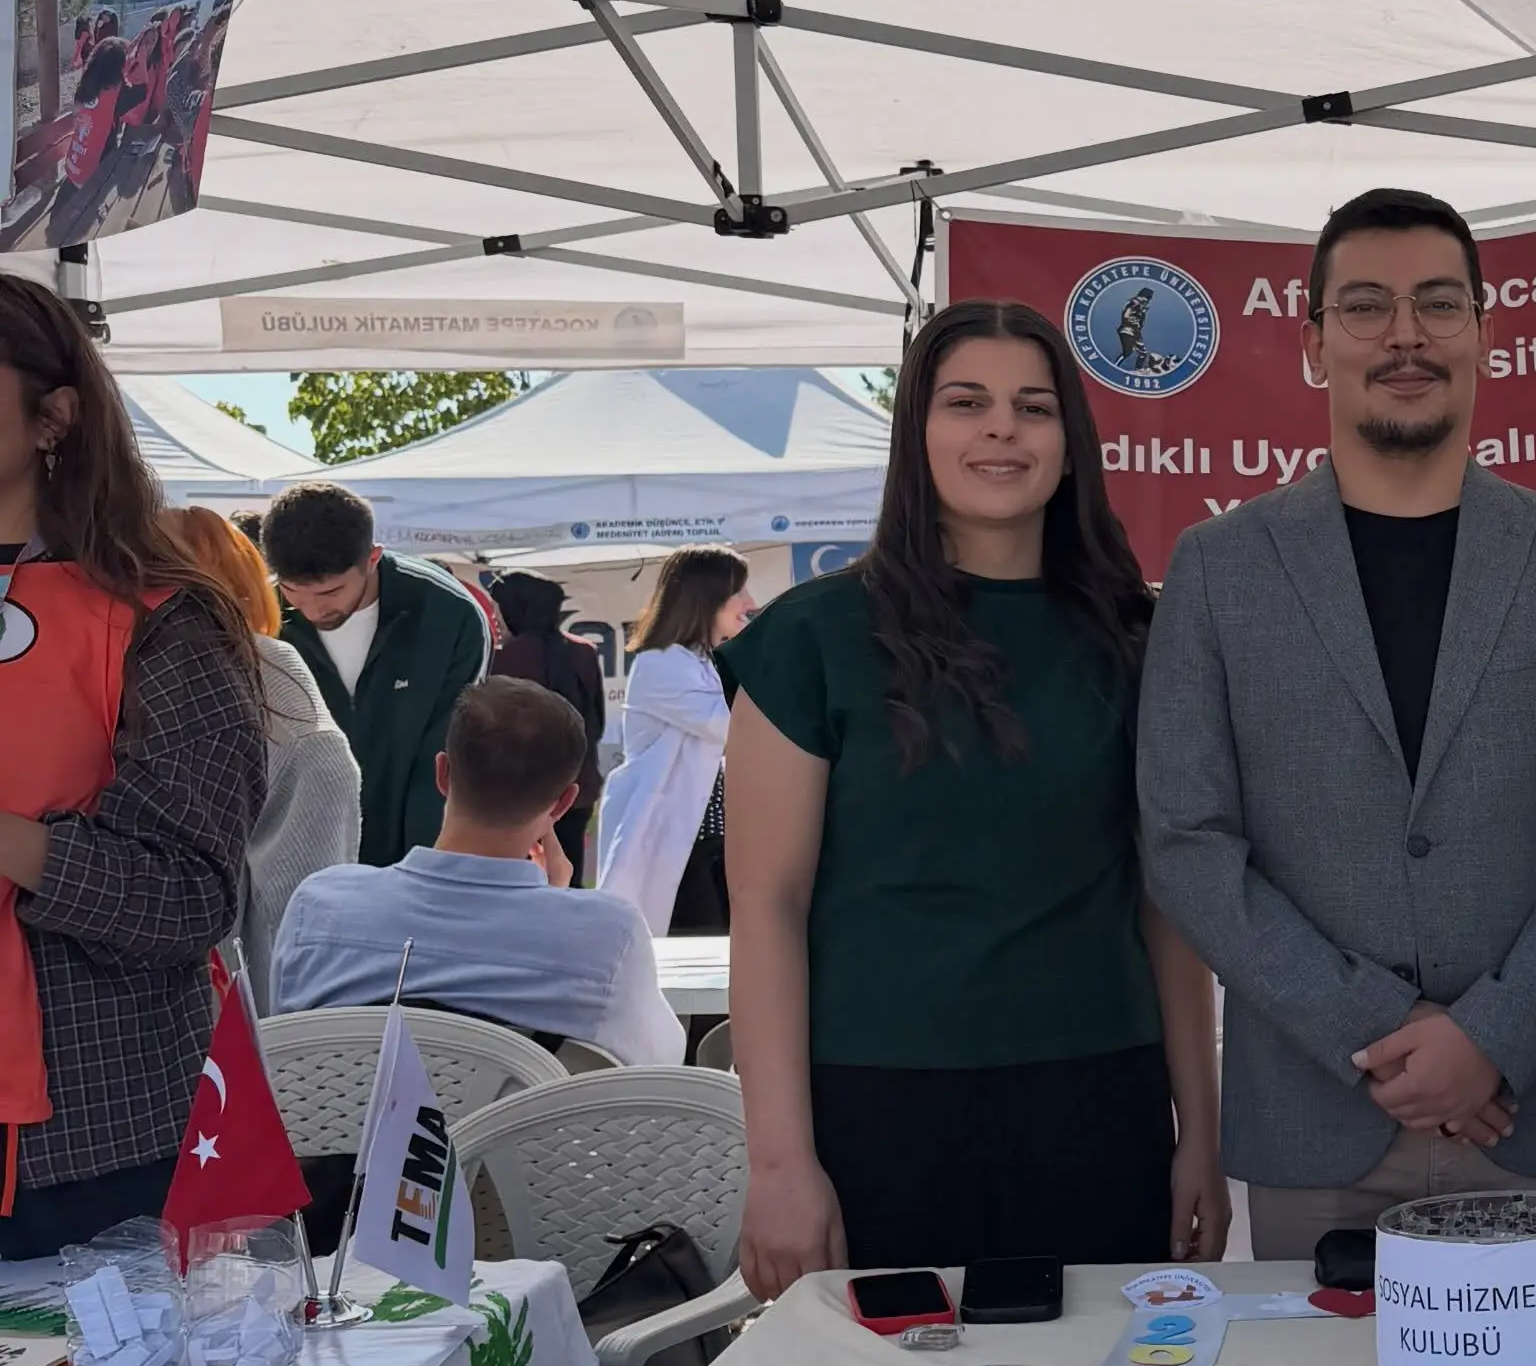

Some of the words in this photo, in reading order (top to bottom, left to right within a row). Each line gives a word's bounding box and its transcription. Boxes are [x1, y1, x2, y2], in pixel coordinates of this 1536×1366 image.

[1080, 265, 1150, 307] KOCATEPE
[1075, 314, 1099, 361] AFYON
[1100, 434, 1210, 474] dıklı
[390, 1105, 449, 1246] TEMA
[1379, 1275, 1439, 1311] SOSYAL
[1400, 1326, 1501, 1357] KULUBÜ
